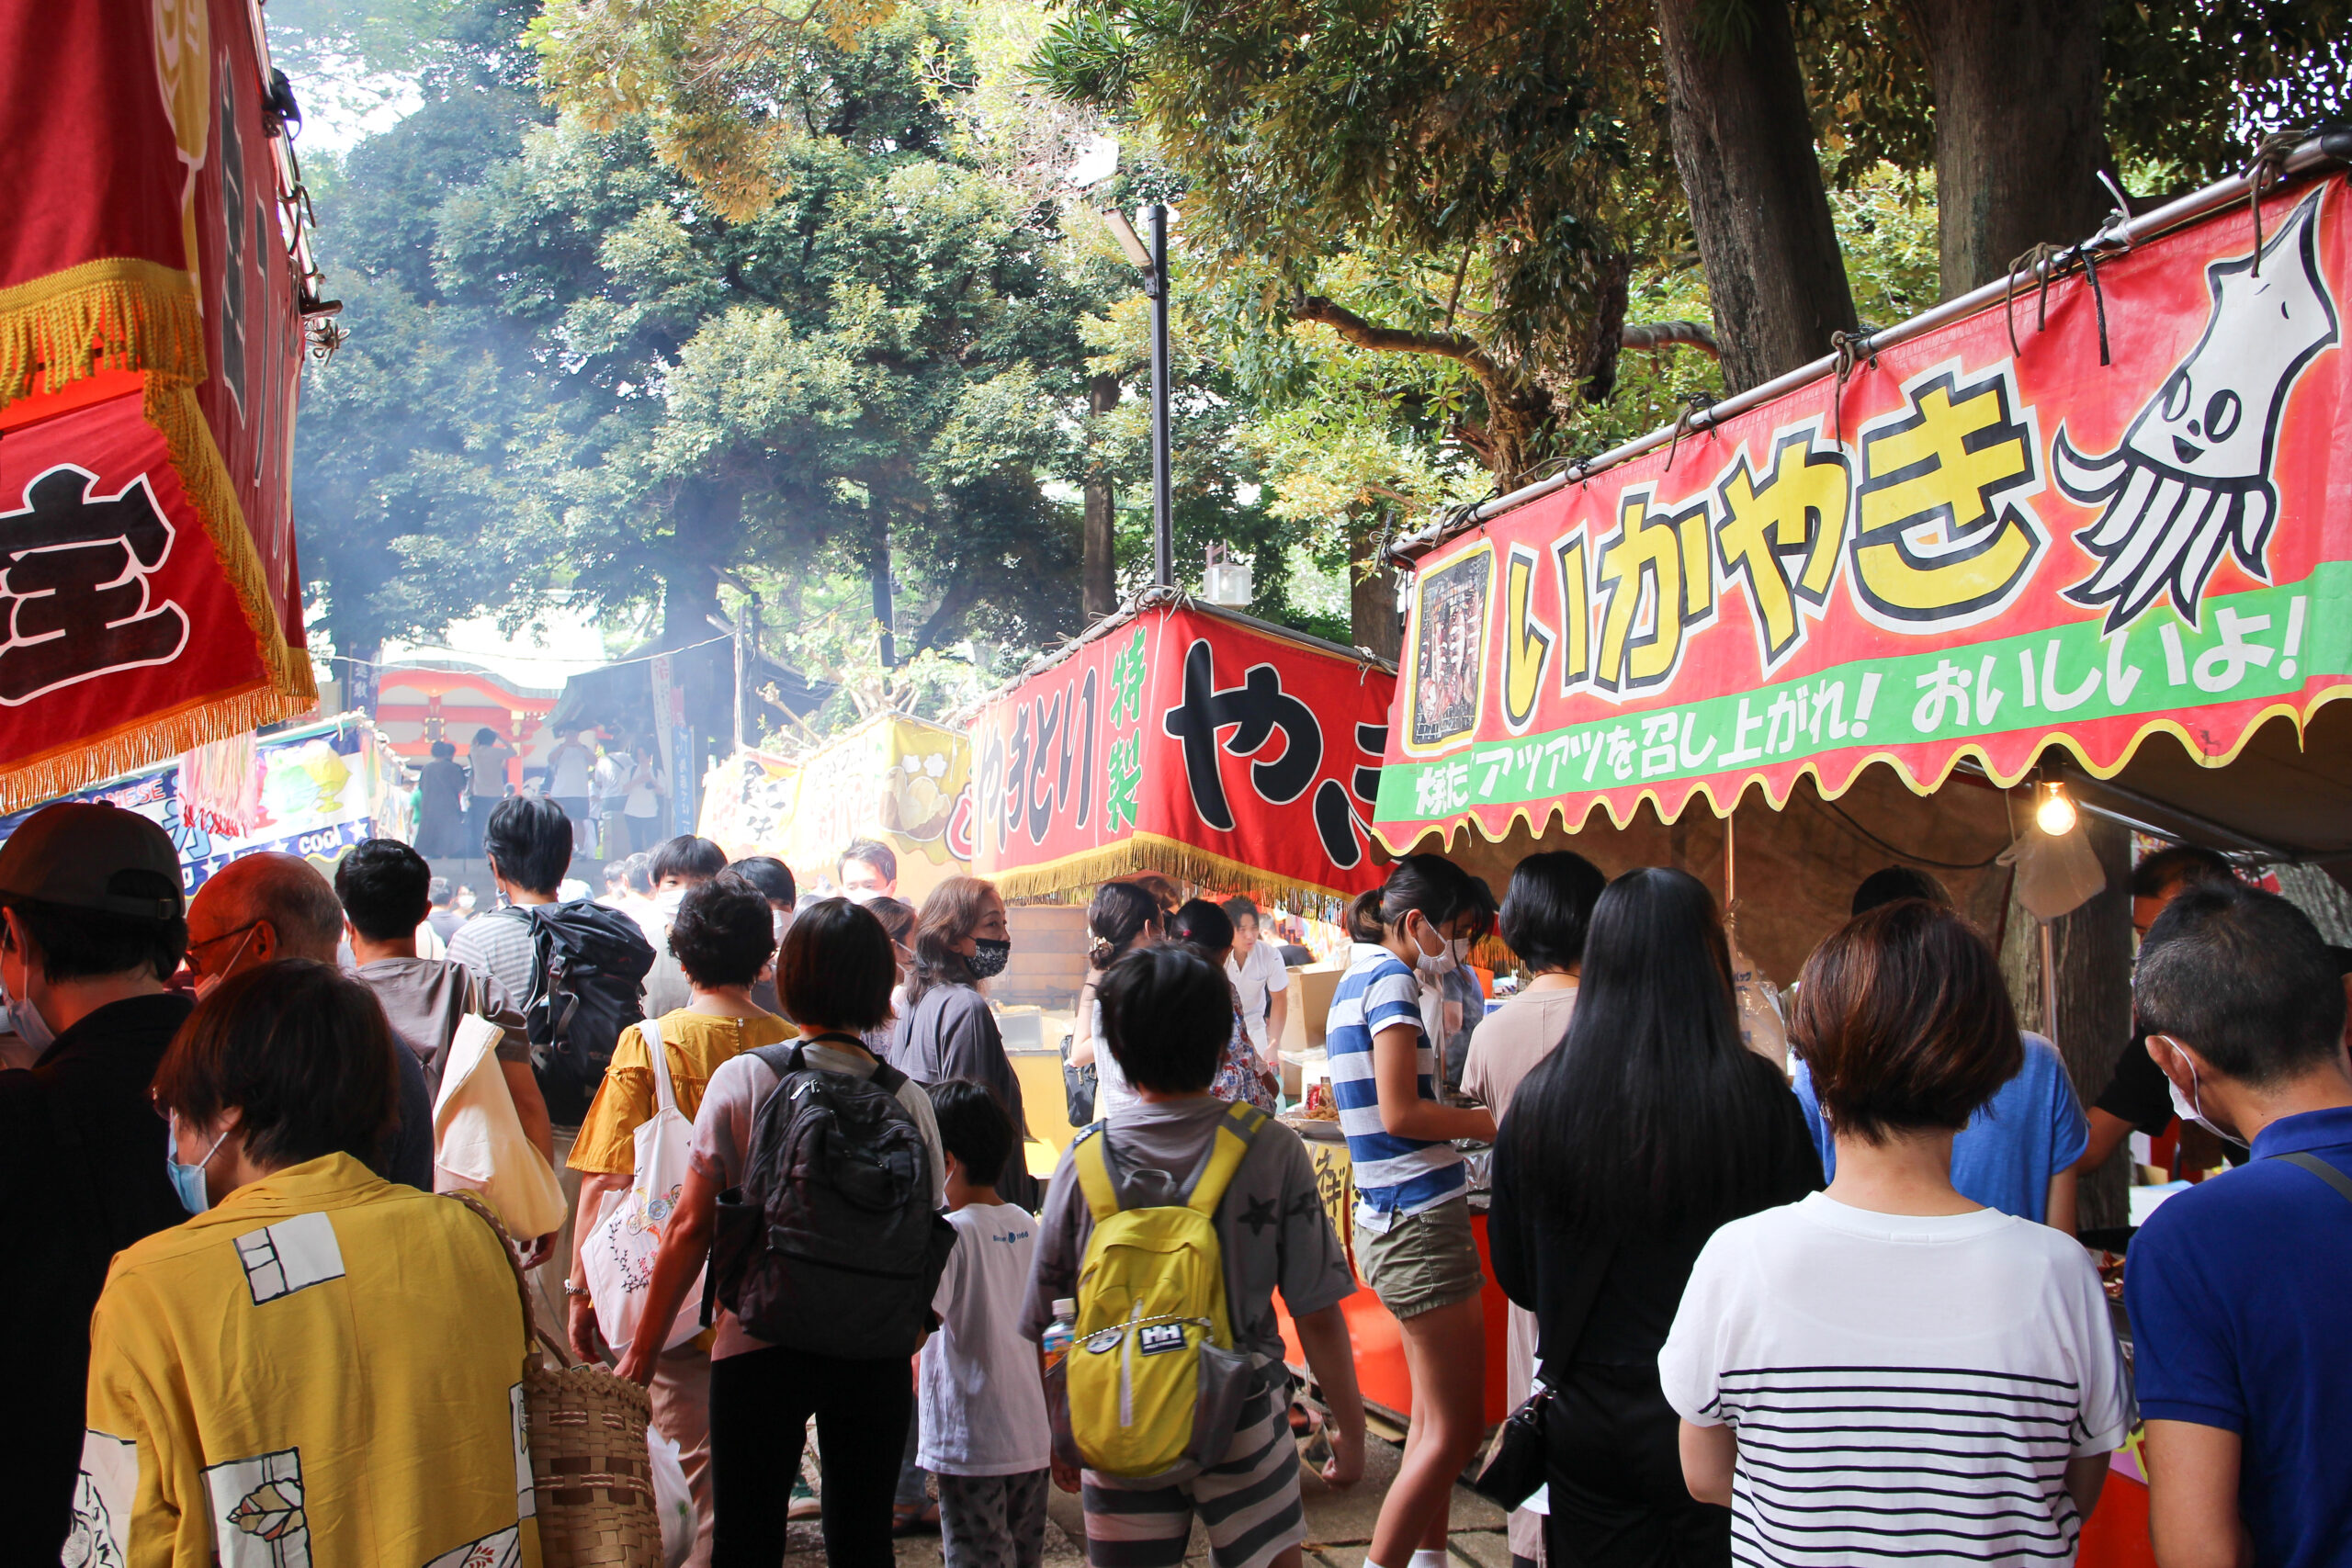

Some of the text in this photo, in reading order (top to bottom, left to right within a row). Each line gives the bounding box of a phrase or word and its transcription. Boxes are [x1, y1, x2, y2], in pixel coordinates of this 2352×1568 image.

[1501, 356, 2052, 735] いかやき
[1106, 625, 1148, 832] 特製
[1912, 595, 2307, 732] おいしいよ!
[299, 826, 343, 855] cool
[976, 665, 1098, 858] やきとり
[1316, 1148, 1345, 1229] ネギ
